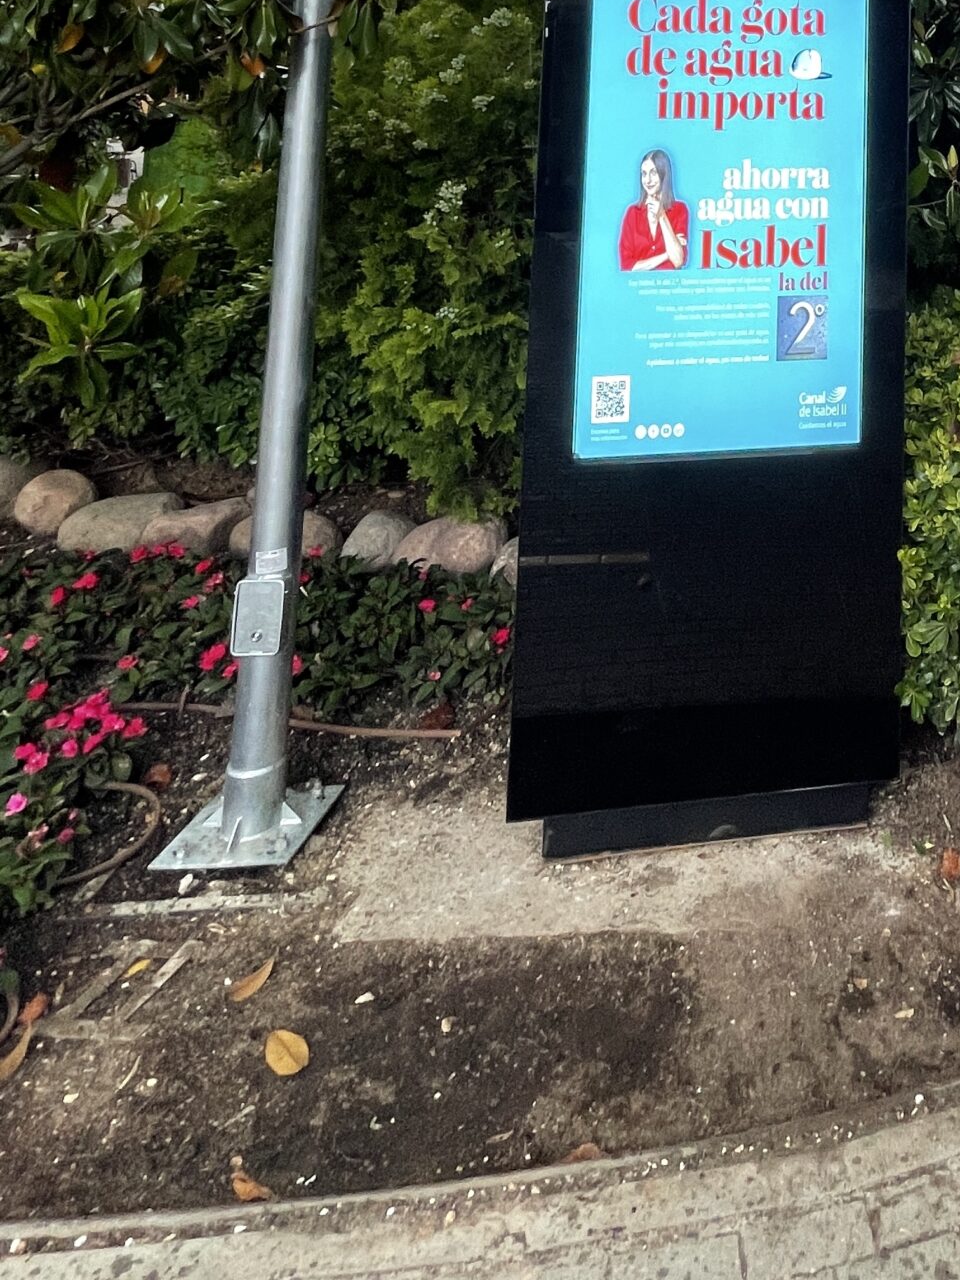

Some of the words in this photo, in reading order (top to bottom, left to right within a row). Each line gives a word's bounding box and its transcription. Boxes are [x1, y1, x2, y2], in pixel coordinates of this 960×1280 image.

[626, 35, 677, 76] de
[684, 39, 783, 86] agua
[656, 78, 825, 131] importa
[723, 158, 830, 190] ahorra
[697, 191, 770, 226] agua
[775, 197, 829, 219] con
[697, 224, 827, 269] Isabel
[779, 272, 795, 291] la
[800, 271, 828, 290] del
[799, 390, 826, 405] Canal
[799, 405, 811, 417] de
[812, 403, 839, 417] Isabel
[841, 403, 847, 415] II
